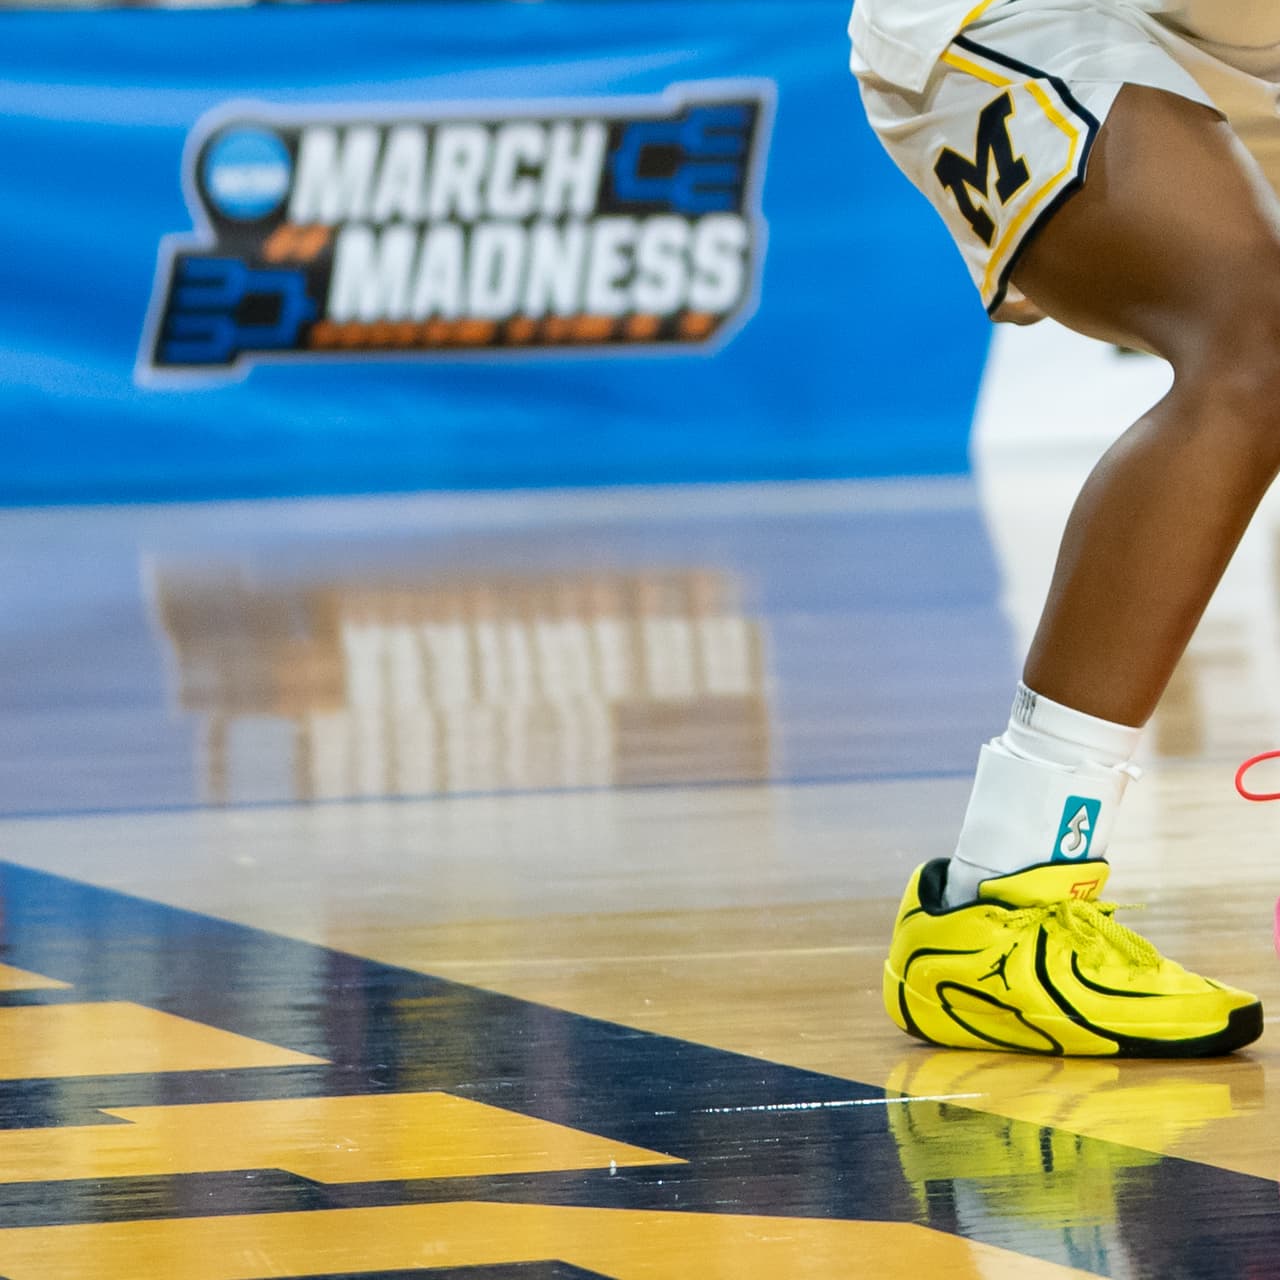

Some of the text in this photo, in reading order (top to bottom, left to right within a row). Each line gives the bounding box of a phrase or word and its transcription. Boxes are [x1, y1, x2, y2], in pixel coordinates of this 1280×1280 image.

[288, 120, 607, 221] MARCH
[934, 89, 1031, 248] M
[327, 214, 747, 323] MADNESS
